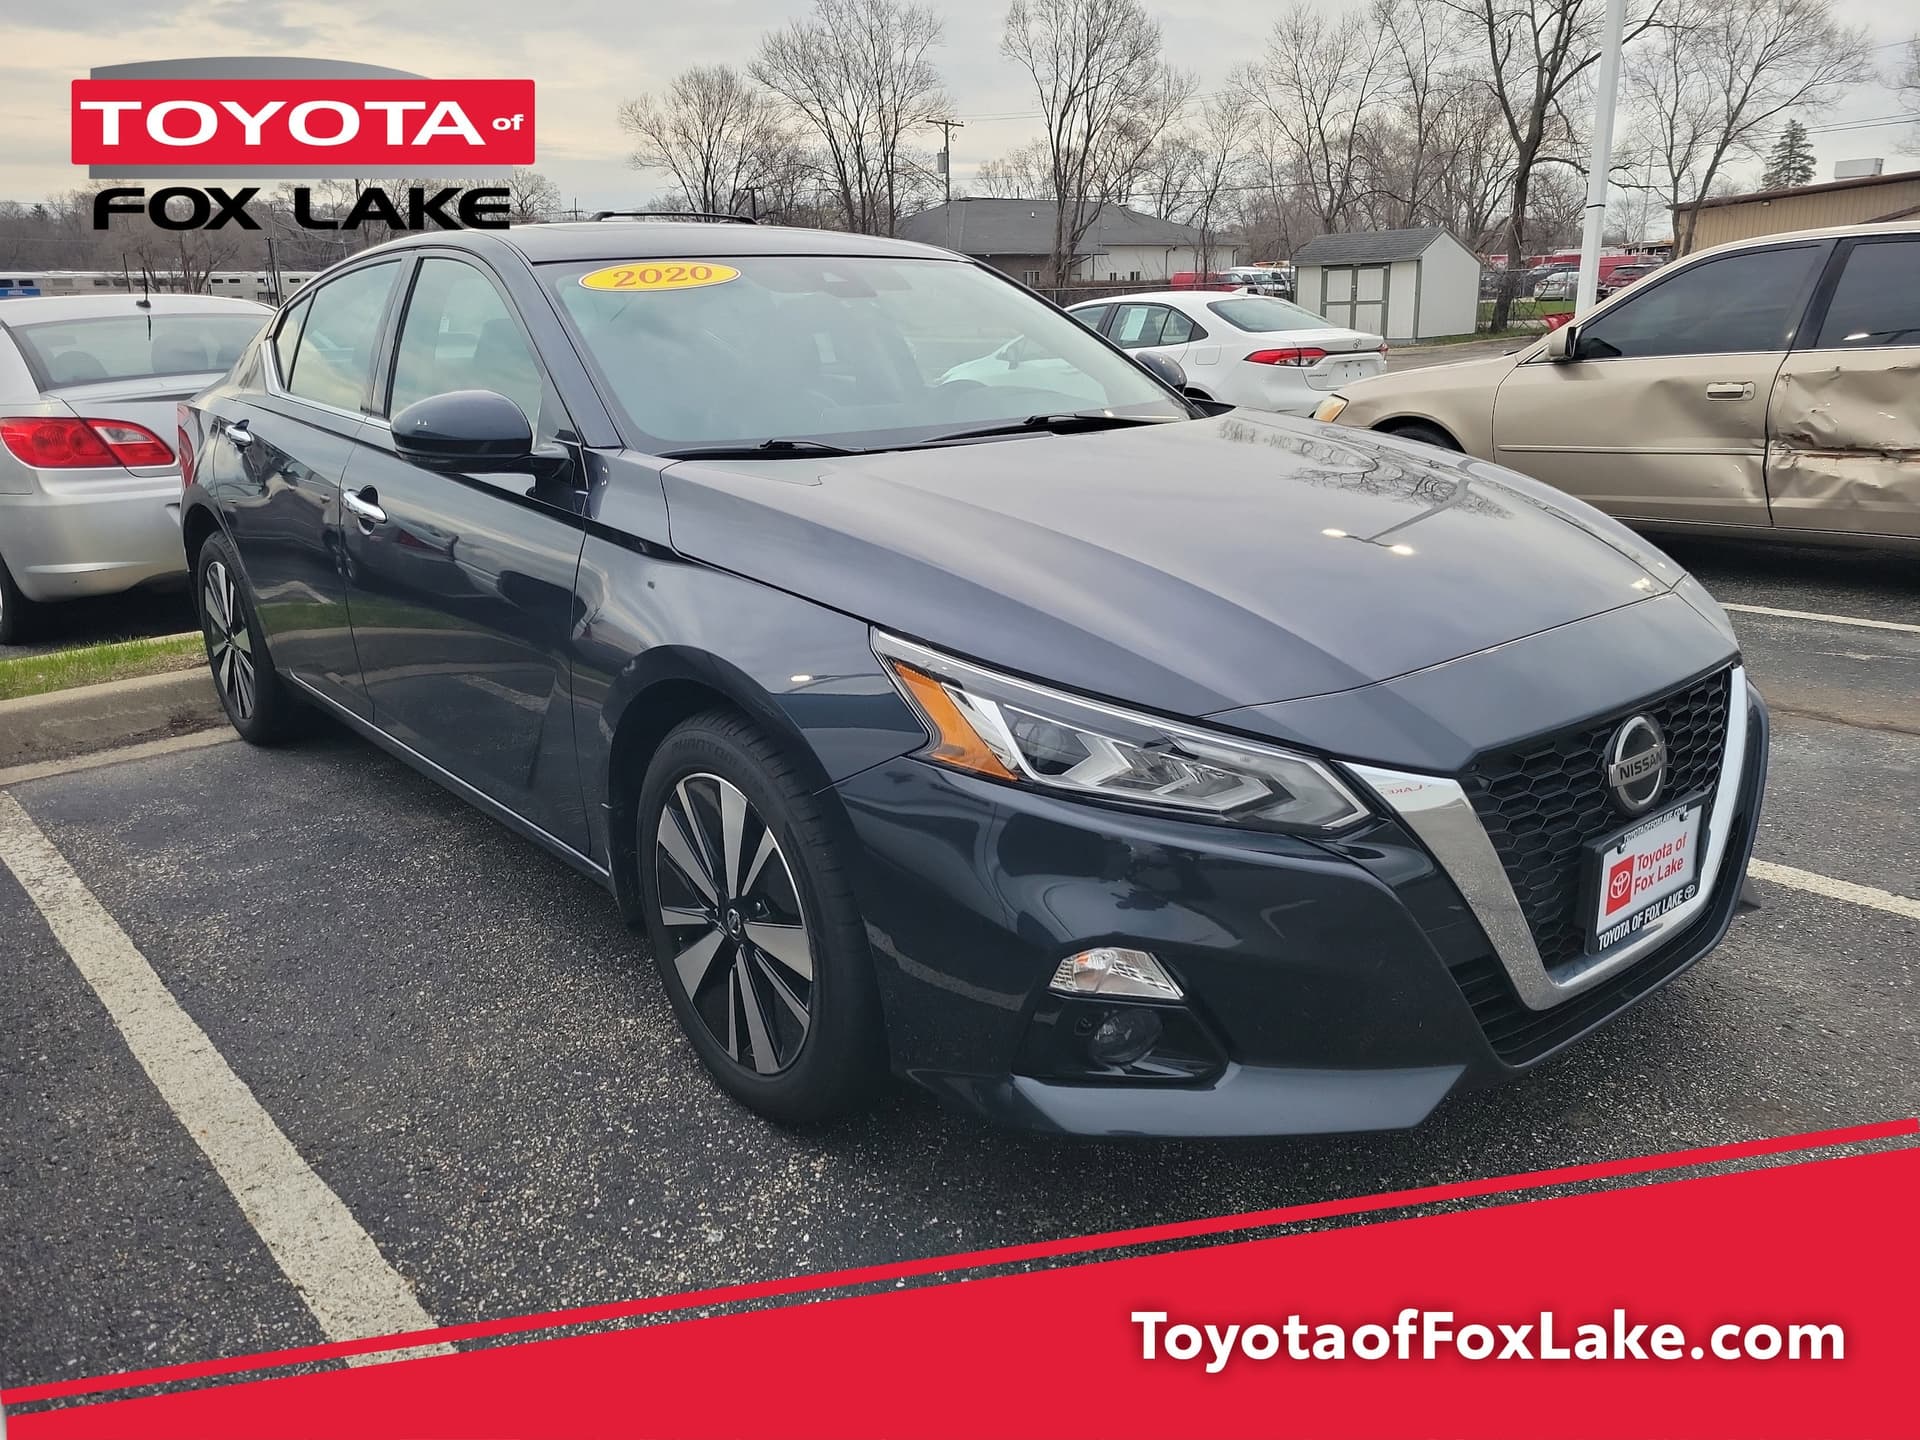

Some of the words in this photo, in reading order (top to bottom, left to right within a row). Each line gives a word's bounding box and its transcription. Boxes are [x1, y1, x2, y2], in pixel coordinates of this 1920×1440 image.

[613, 266, 713, 288] 2020
[1619, 750, 1662, 780] NISSAN
[1637, 842, 1673, 871] Toyota
[1675, 831, 1688, 851] of
[1633, 872, 1655, 895] Fox
[1657, 857, 1684, 882] Lake
[1598, 919, 1631, 951] TOYOTA
[1631, 911, 1644, 931] OF
[1644, 902, 1662, 924] FOX
[1662, 889, 1684, 914] LAKE
